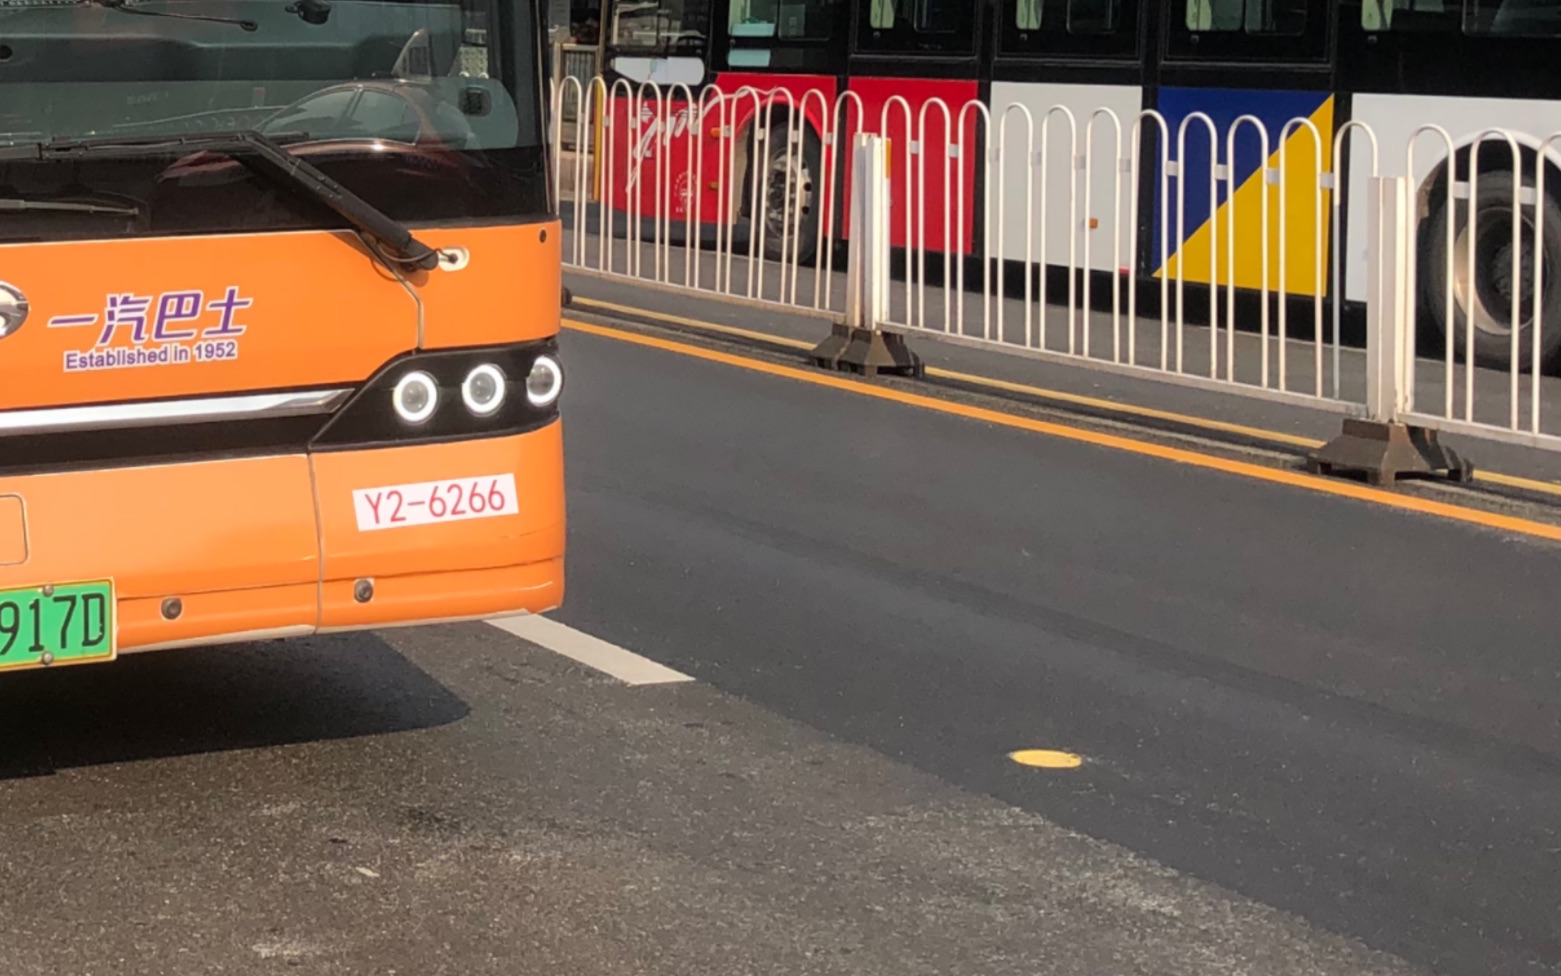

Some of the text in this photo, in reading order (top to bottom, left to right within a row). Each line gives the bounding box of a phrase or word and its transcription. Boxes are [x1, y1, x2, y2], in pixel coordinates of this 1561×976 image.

[49, 287, 253, 345] 一汽巴士
[65, 342, 237, 370] Established in 1952
[363, 479, 507, 525] Y2-6266
